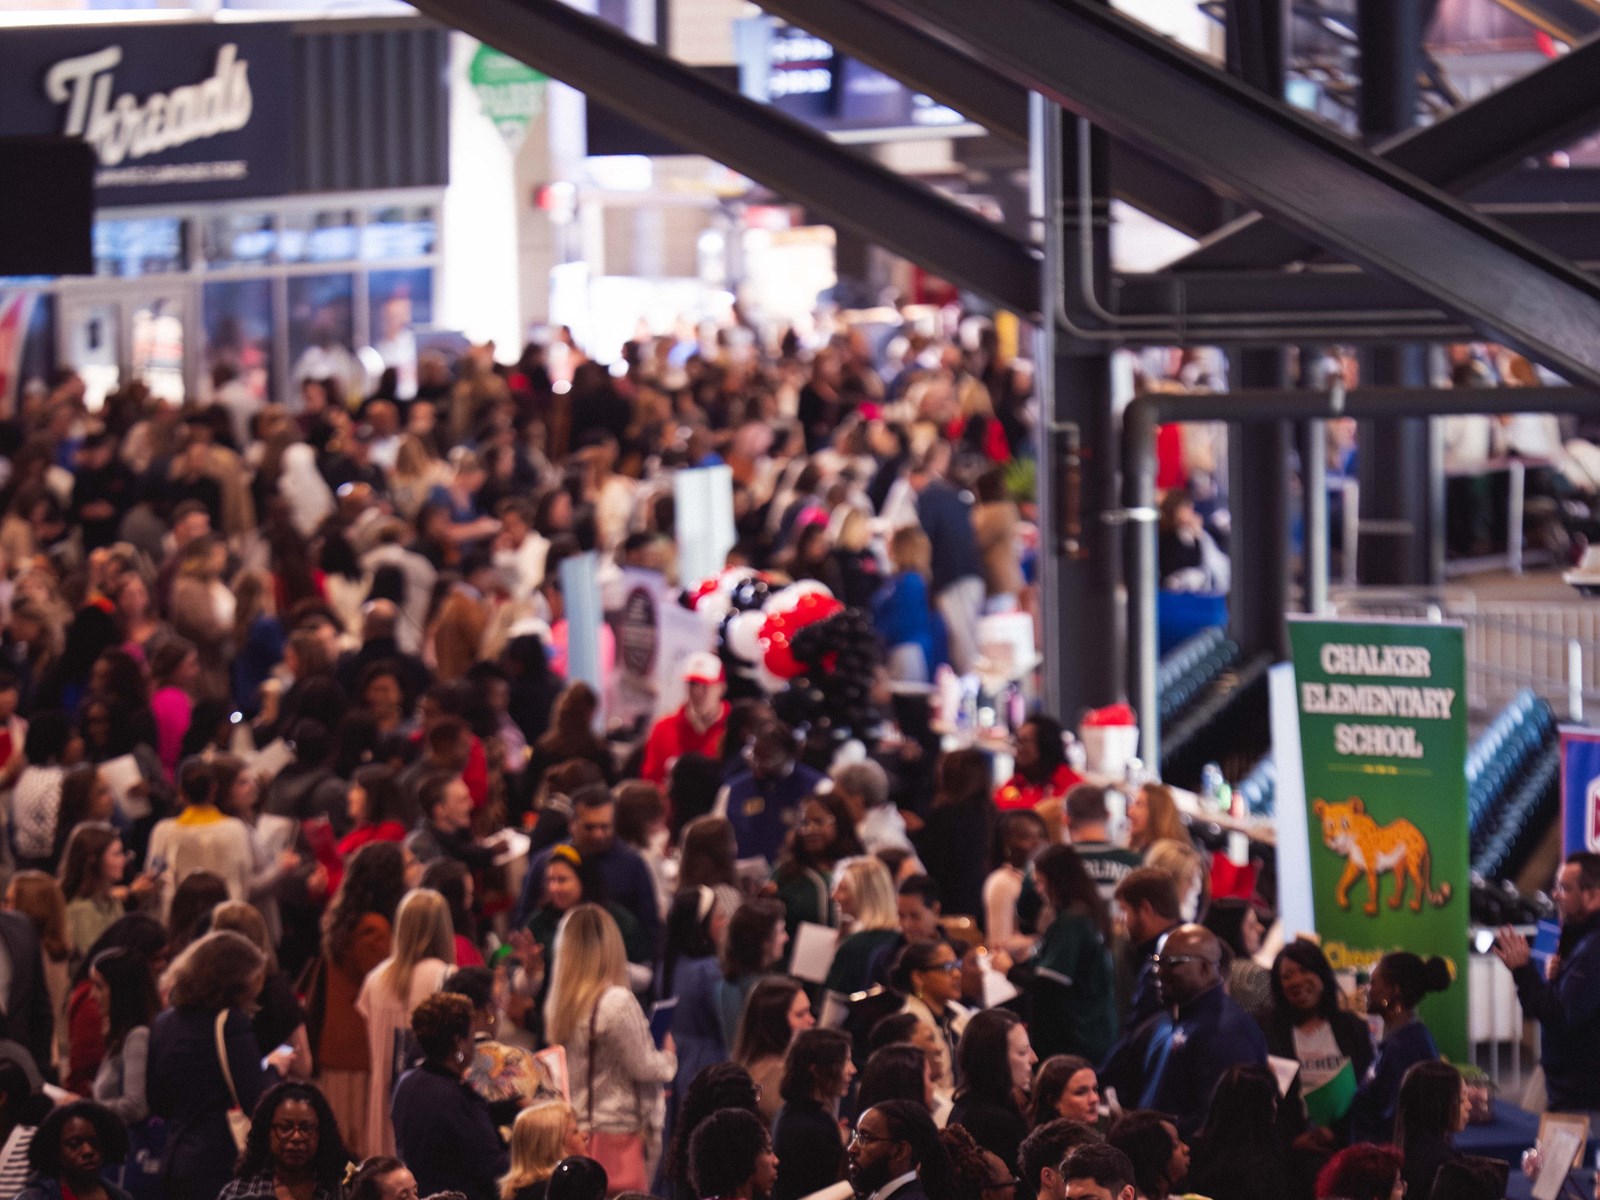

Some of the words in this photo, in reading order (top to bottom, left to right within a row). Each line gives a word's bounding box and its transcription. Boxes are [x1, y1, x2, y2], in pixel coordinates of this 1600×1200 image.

[45, 43, 252, 166] Threads
[1320, 642, 1431, 678] CHALKER
[1302, 682, 1456, 720] ELEMENTARY
[1334, 722, 1424, 759] SCHOOL
